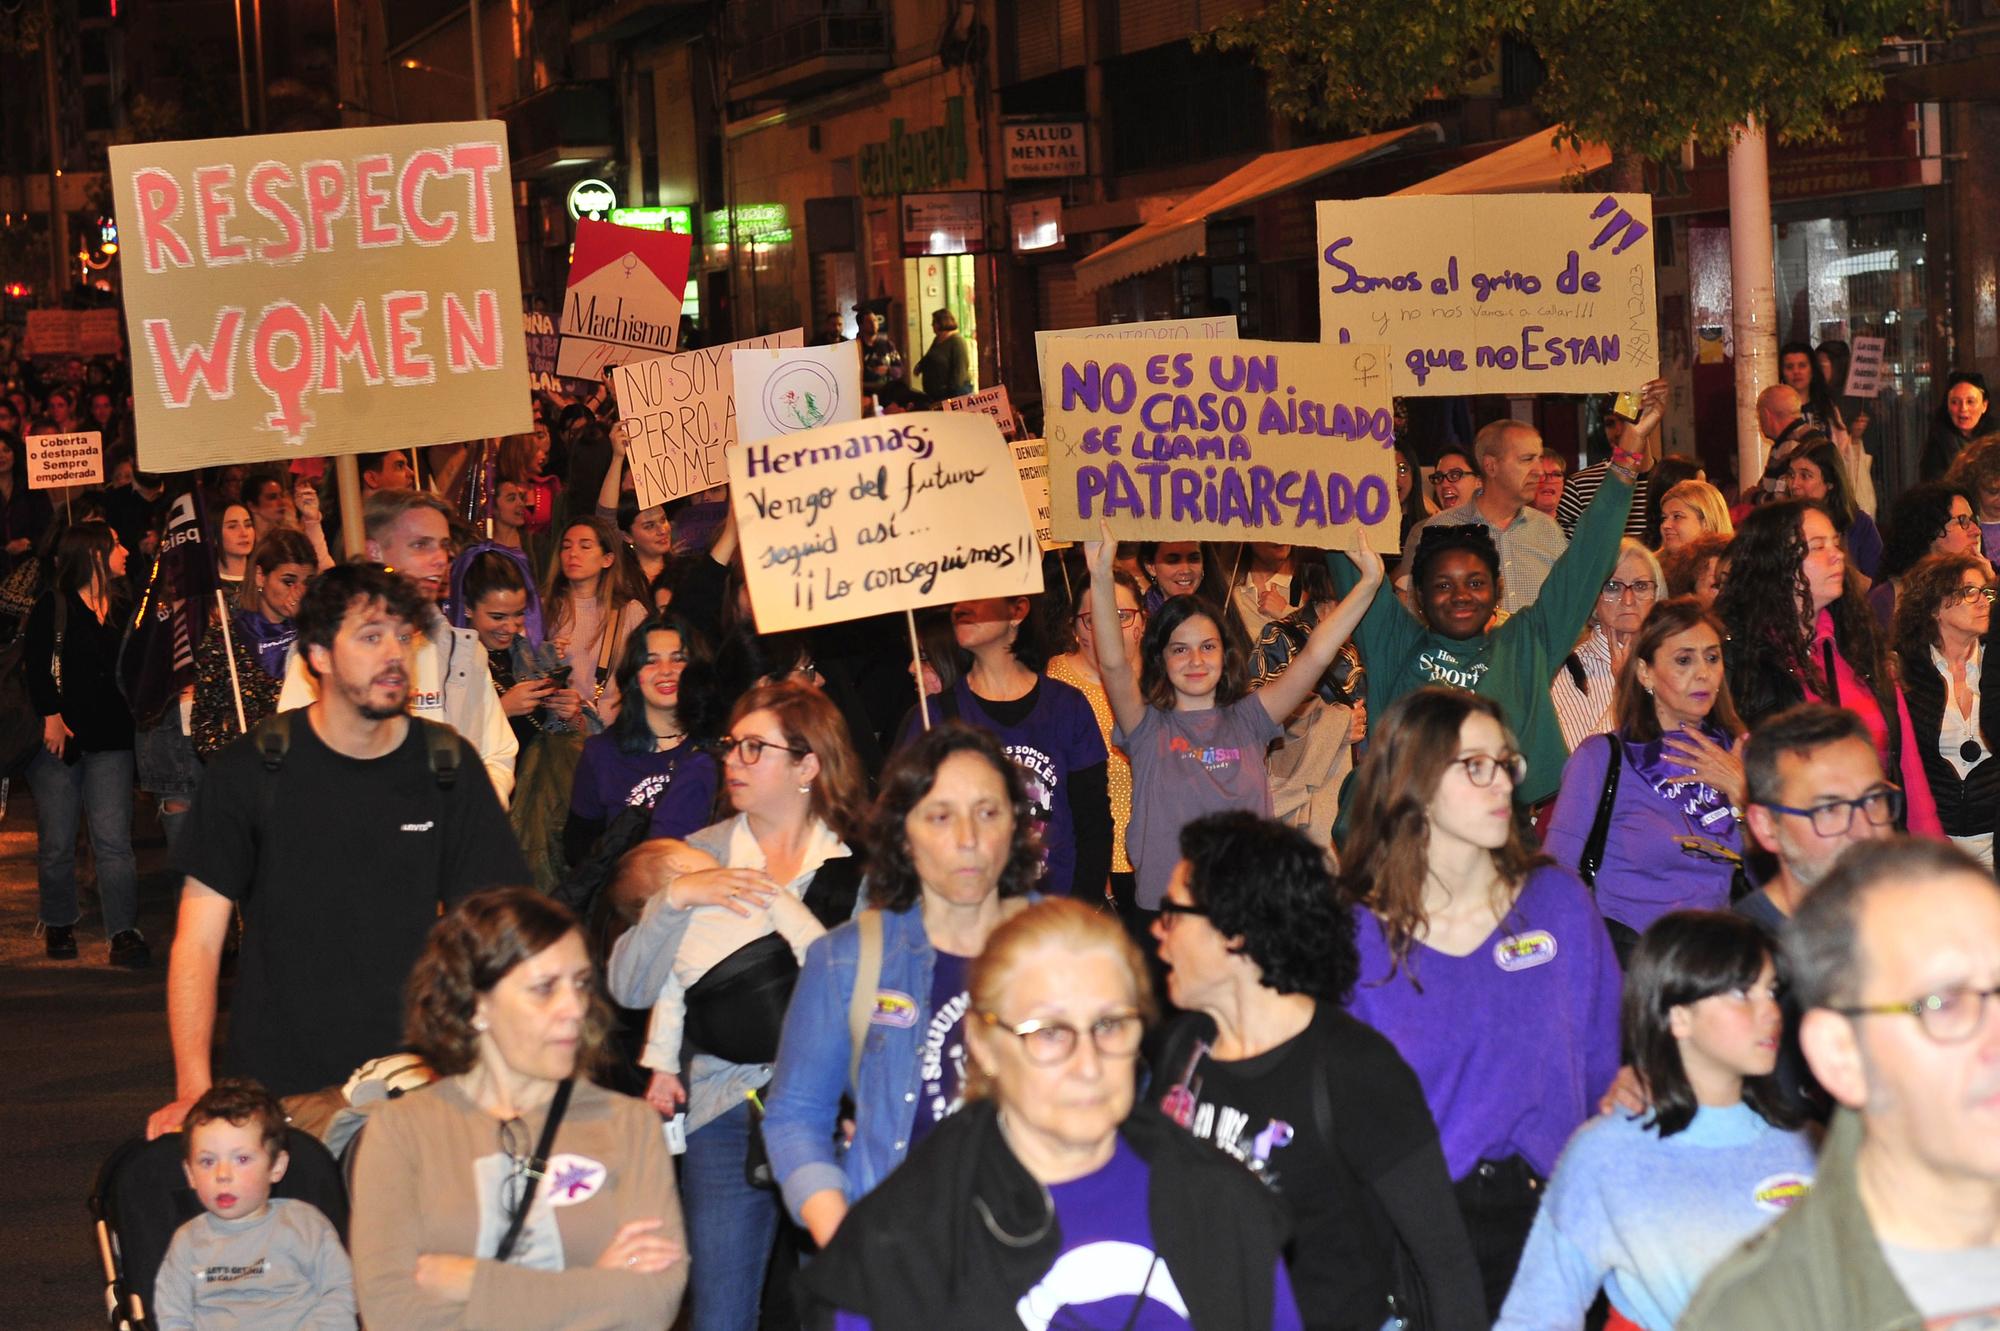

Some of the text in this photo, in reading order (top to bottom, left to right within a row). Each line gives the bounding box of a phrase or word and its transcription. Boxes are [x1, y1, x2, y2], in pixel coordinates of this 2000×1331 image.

[1011, 143, 1079, 160] MENTAL
[1016, 126, 1073, 141] SALUD
[132, 142, 503, 274] RESPECT
[1324, 236, 1601, 302] Somos el grito de
[568, 292, 672, 348] Machismo
[1371, 309, 1391, 335] y
[1400, 308, 1422, 321] no
[1431, 306, 1464, 319] nos
[143, 289, 503, 445] WOMEN
[624, 360, 663, 413] NO
[671, 346, 725, 402] SOY
[1061, 353, 1279, 414] NO ES UN
[1405, 349, 1468, 387] que
[950, 391, 1000, 411] El Amor
[1140, 392, 1248, 433] CASO
[40, 436, 88, 448] Coberta
[625, 401, 710, 464] PERRO
[1080, 425, 1252, 462] SE LLAMA
[30, 446, 99, 460] o destapada
[43, 458, 88, 470] Sempre
[36, 469, 96, 482] empoderada
[643, 456, 679, 507] NO
[748, 460, 989, 526] Vengo del futuro
[760, 526, 838, 575] seguid
[1015, 745, 1050, 764] SOMOS
